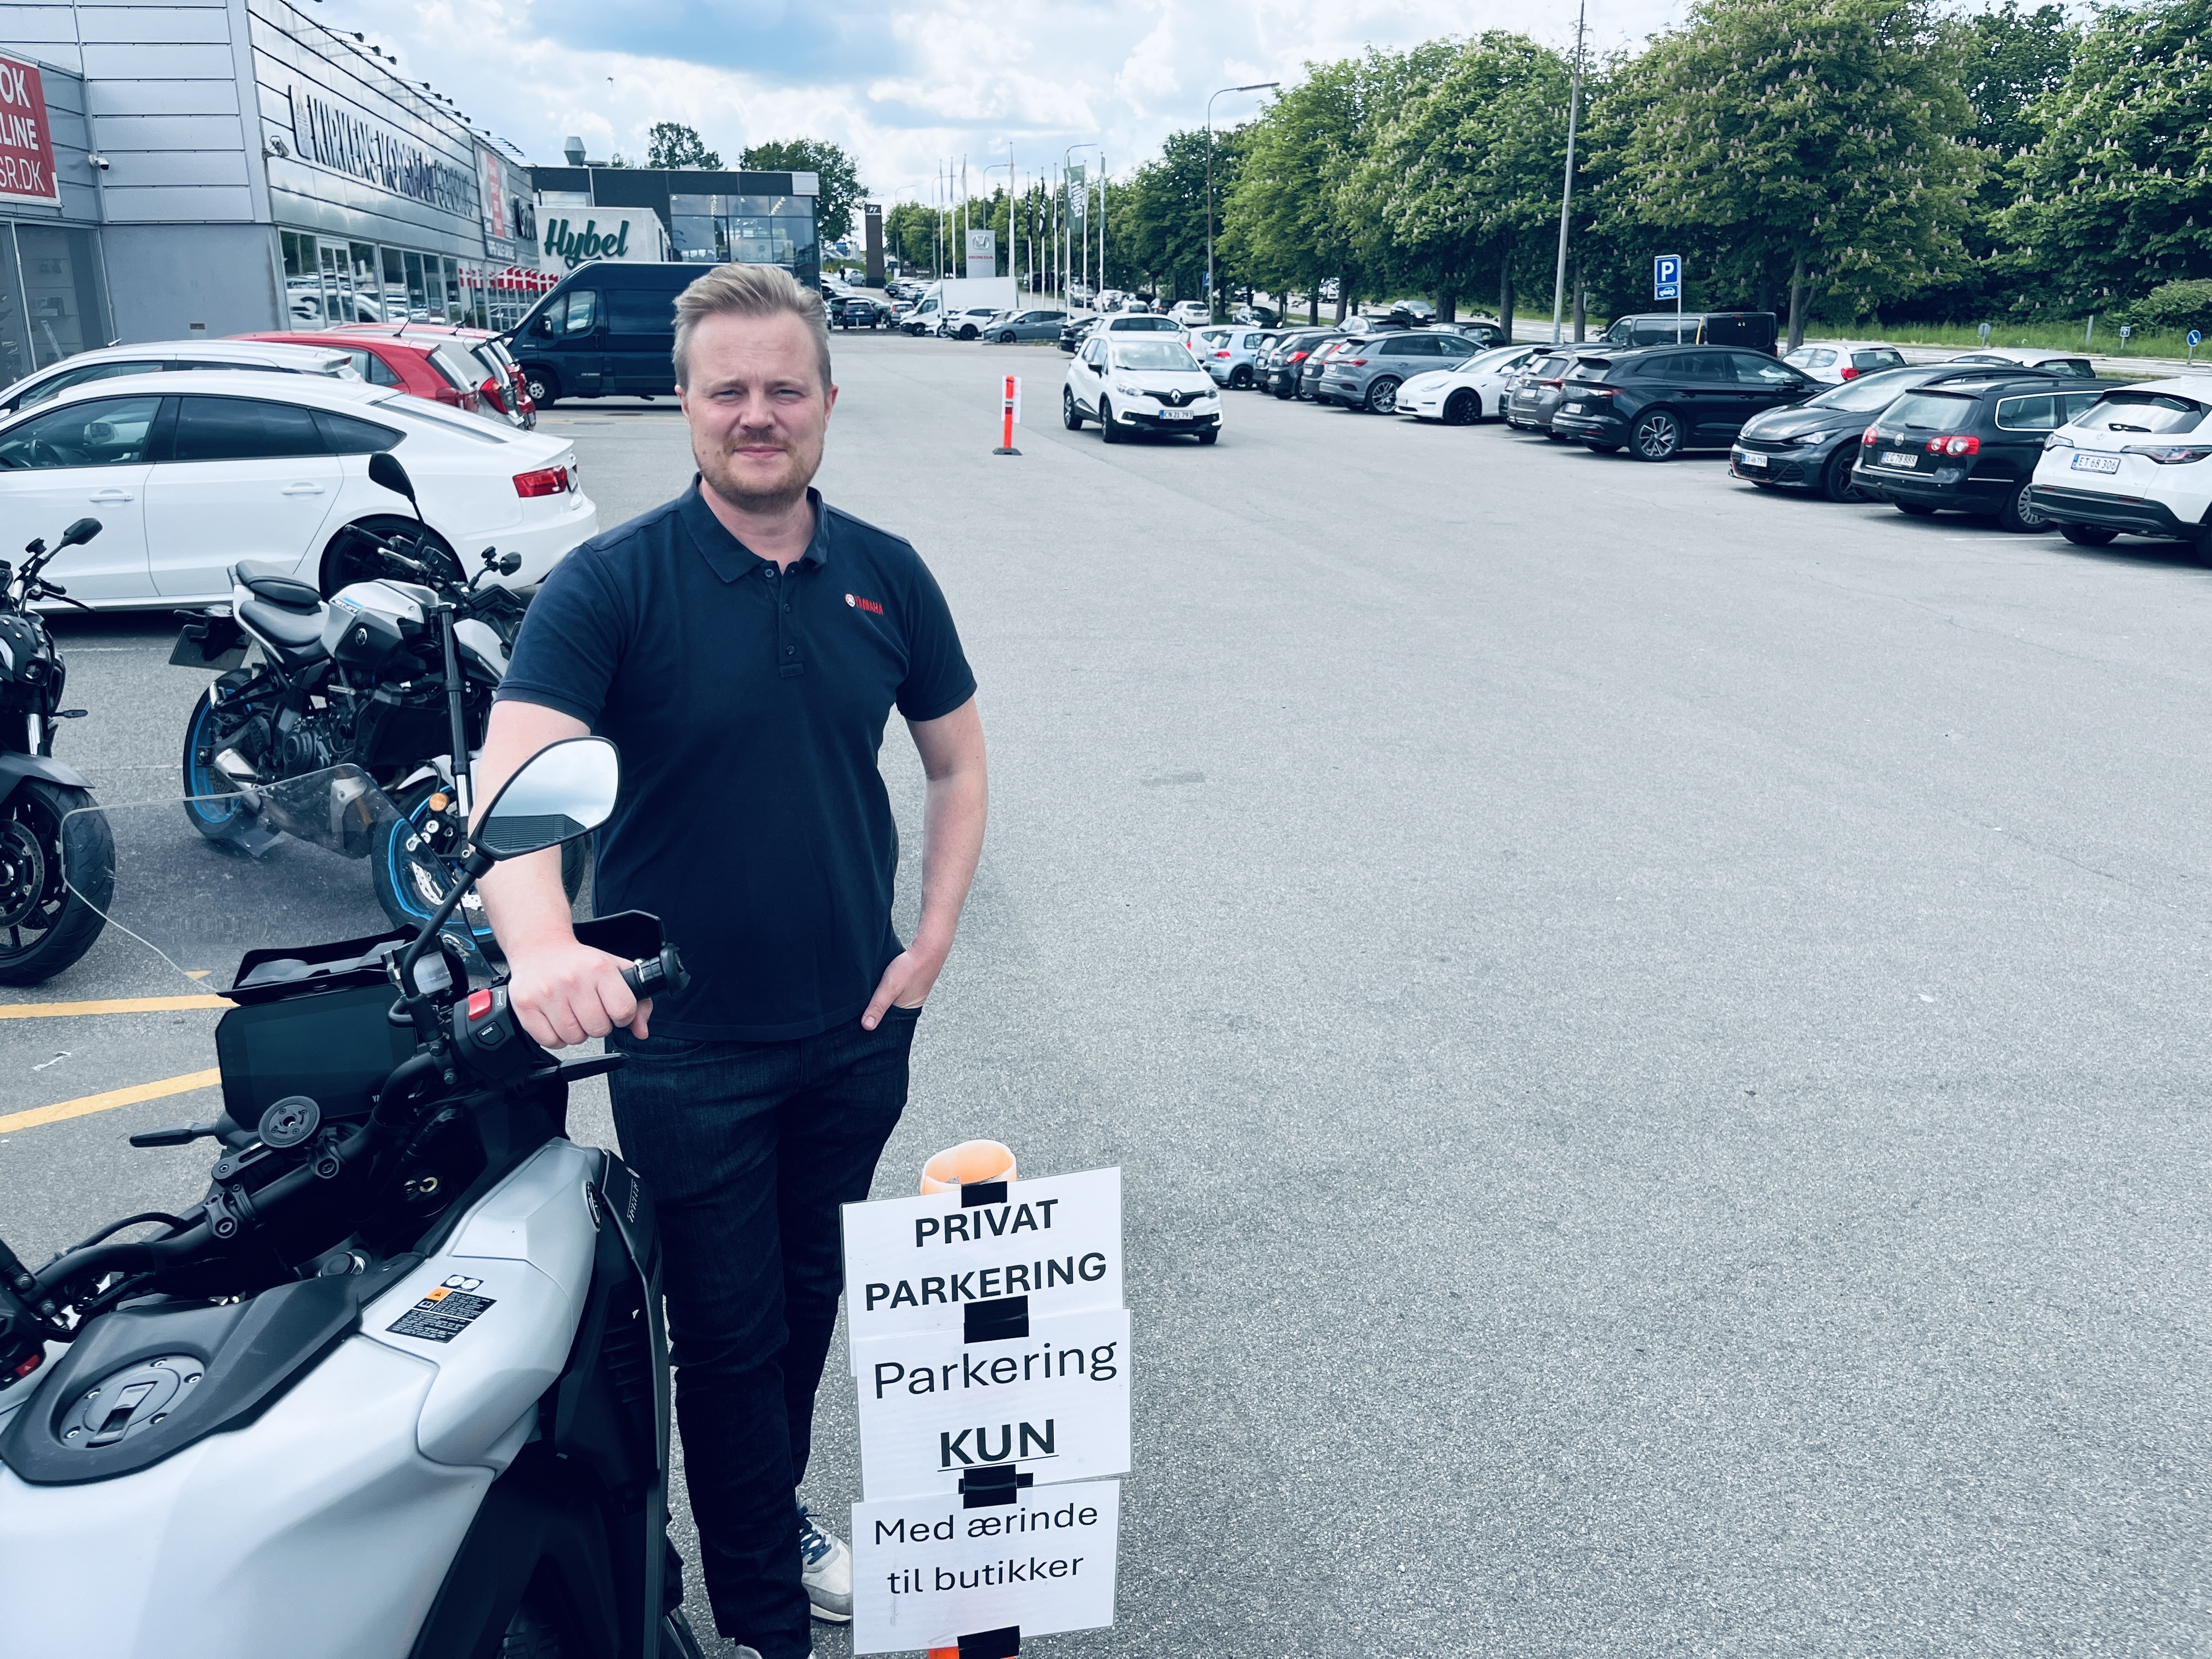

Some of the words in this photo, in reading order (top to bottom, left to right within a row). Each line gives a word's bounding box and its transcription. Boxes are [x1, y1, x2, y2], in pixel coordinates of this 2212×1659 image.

[0, 112, 39, 151] LINE
[544, 219, 630, 270] Hybel
[1661, 261, 1674, 281] P
[2079, 457, 2090, 466] ET
[2090, 459, 2101, 468] 68
[2101, 460, 2117, 470] 306
[481, 1026, 493, 1036] MODE
[915, 1199, 1058, 1248] PRIVAT
[865, 1252, 1107, 1311] PARKERING
[874, 1341, 1117, 1399] Parkering
[940, 1419, 1055, 1468] KUN
[876, 1514, 955, 1545] Med
[967, 1503, 1098, 1538] ærinde
[887, 1568, 923, 1594] til
[935, 1556, 1084, 1592] butikker
